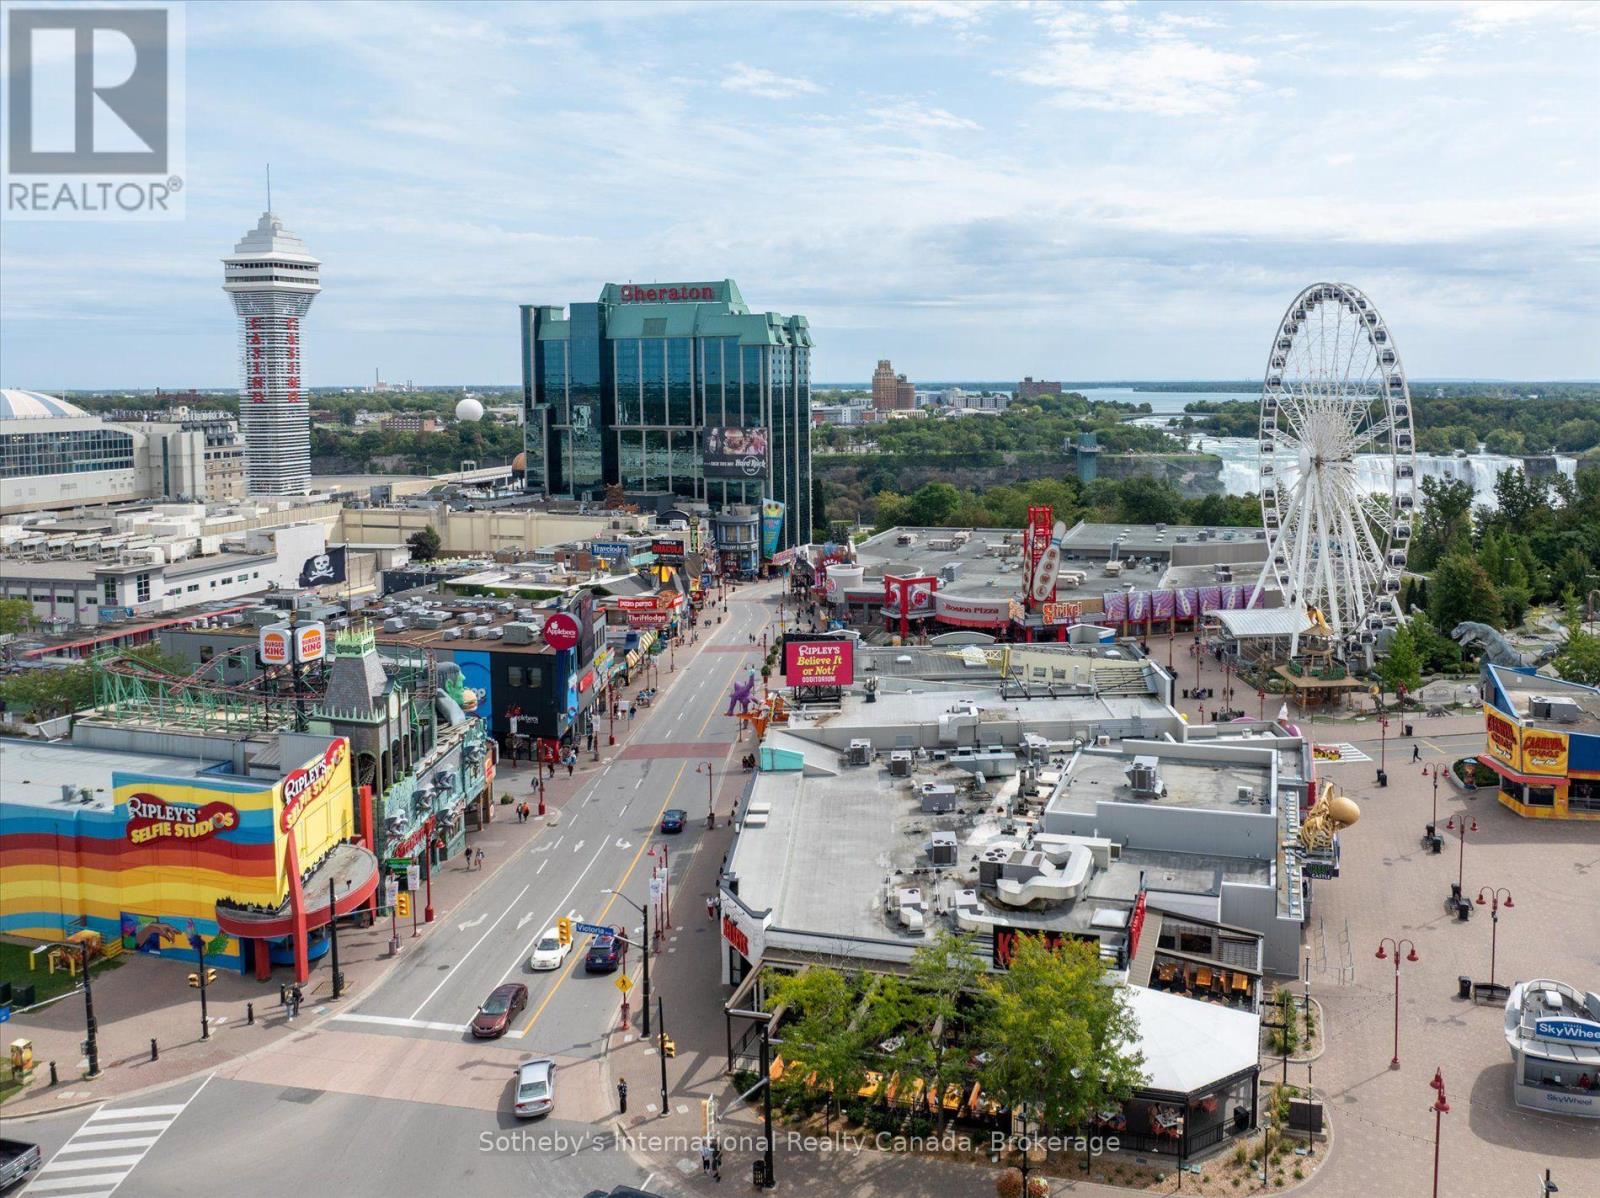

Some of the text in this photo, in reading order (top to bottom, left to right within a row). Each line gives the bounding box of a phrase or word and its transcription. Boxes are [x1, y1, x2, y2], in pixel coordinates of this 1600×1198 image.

[621, 284, 713, 302] Sheraton
[250, 317, 264, 404] CASINO
[287, 317, 299, 404] CASINO
[652, 545, 683, 554] DRACULA
[628, 614, 666, 622] Thriftlodge
[302, 636, 321, 645] BURGER
[264, 647, 285, 655] KING
[302, 642, 322, 653] KING
[798, 645, 840, 656] RIPLEY'S
[796, 655, 842, 666] Believe It
[815, 665, 836, 675] Not!
[284, 760, 327, 805] RIPLEY'S
[126, 797, 196, 822] RIPLEY'S
[131, 812, 234, 843] SELFIE STUDIOS
[577, 924, 604, 934] Victoria
[1539, 1023, 1600, 1038] SkyWhee
[1546, 1094, 1593, 1105] SkyWheel
